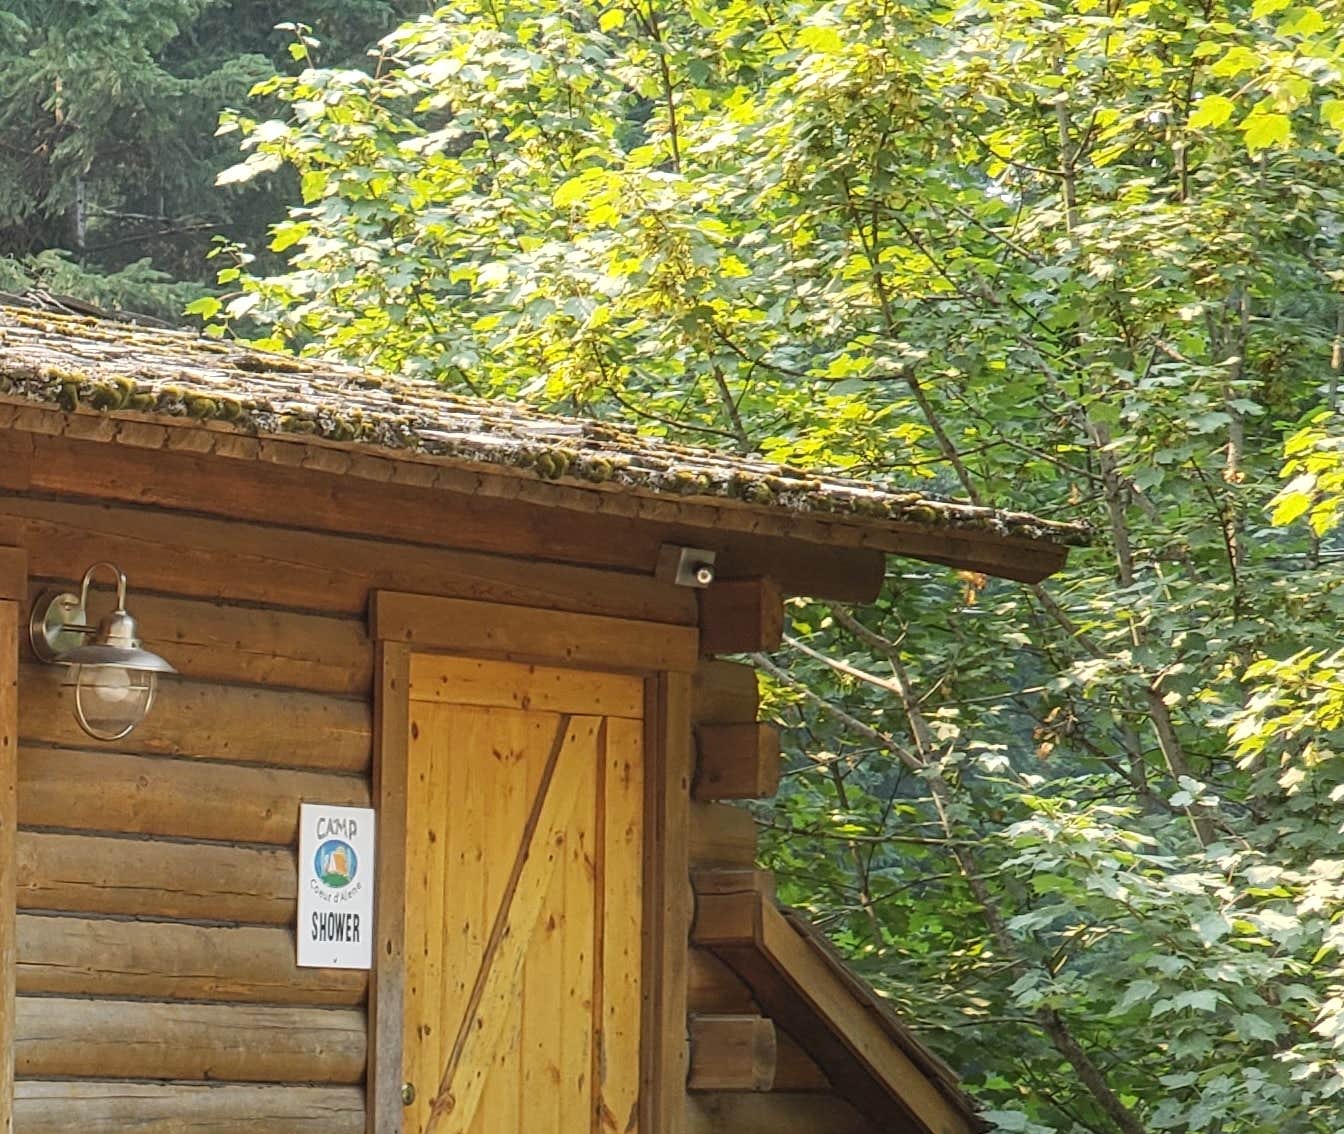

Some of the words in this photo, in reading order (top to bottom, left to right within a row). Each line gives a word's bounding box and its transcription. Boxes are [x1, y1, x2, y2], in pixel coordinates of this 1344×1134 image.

[316, 817, 357, 840] CAMP
[311, 878, 331, 902] Coeur
[312, 911, 360, 943] SHOWER
